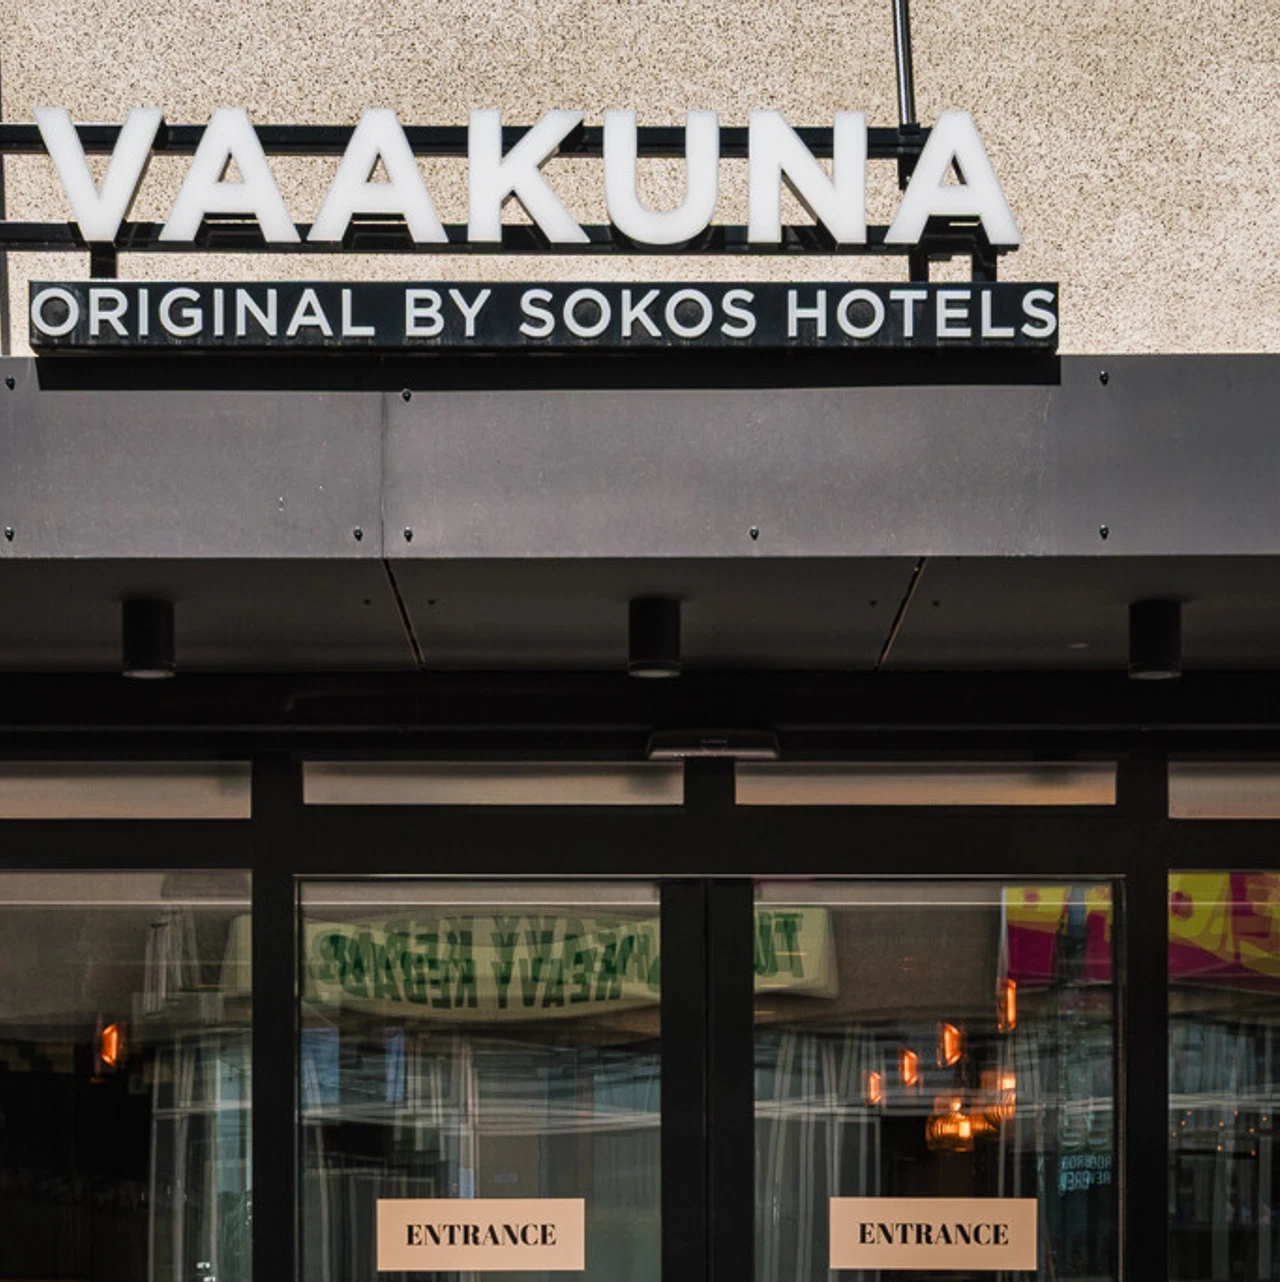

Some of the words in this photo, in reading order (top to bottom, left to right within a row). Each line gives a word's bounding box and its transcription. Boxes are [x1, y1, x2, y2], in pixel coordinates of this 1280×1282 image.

[33, 107, 1020, 246] VAAKUNA
[31, 287, 375, 338] ORIGINAL
[406, 288, 491, 337] BY
[520, 287, 756, 338] SOKOS
[788, 288, 1057, 338] HOTELS
[406, 1223, 557, 1246] ENTRANCE
[858, 1222, 1009, 1245] ENTRANCE
